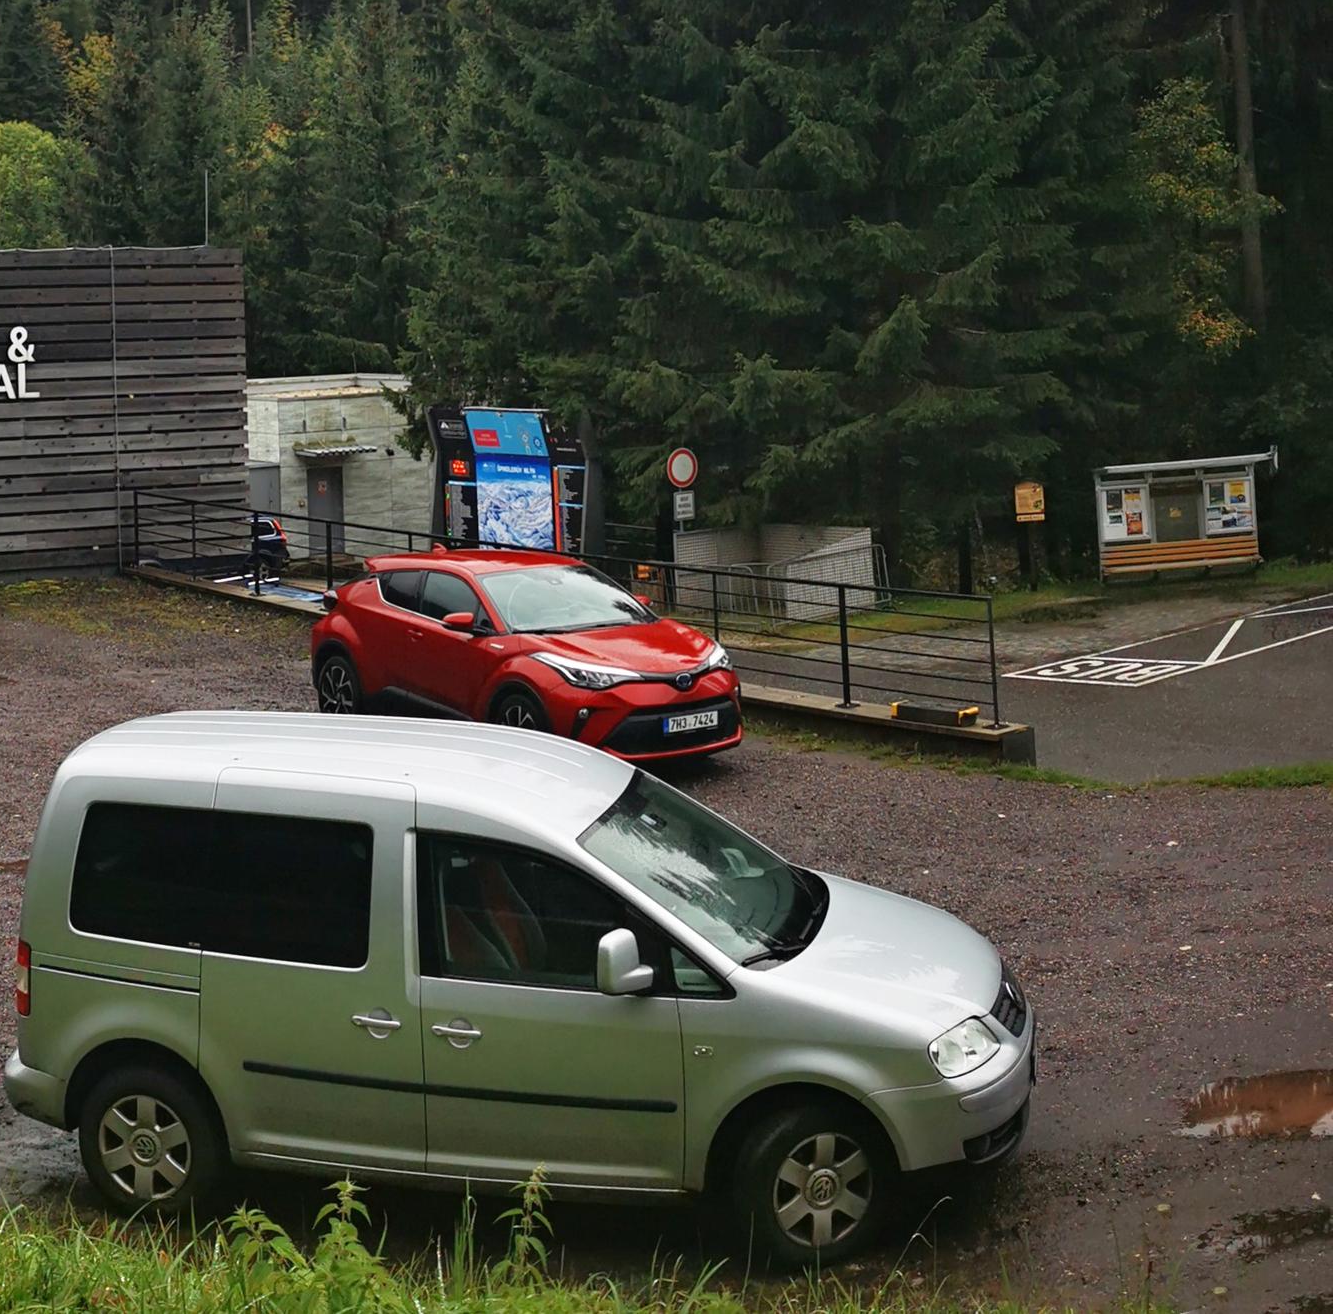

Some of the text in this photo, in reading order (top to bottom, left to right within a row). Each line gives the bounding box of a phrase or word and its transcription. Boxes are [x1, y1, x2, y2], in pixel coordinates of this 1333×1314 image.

[7, 326, 36, 364] &
[1037, 660, 1187, 682] BUS
[671, 713, 714, 731] 7H3 7424
